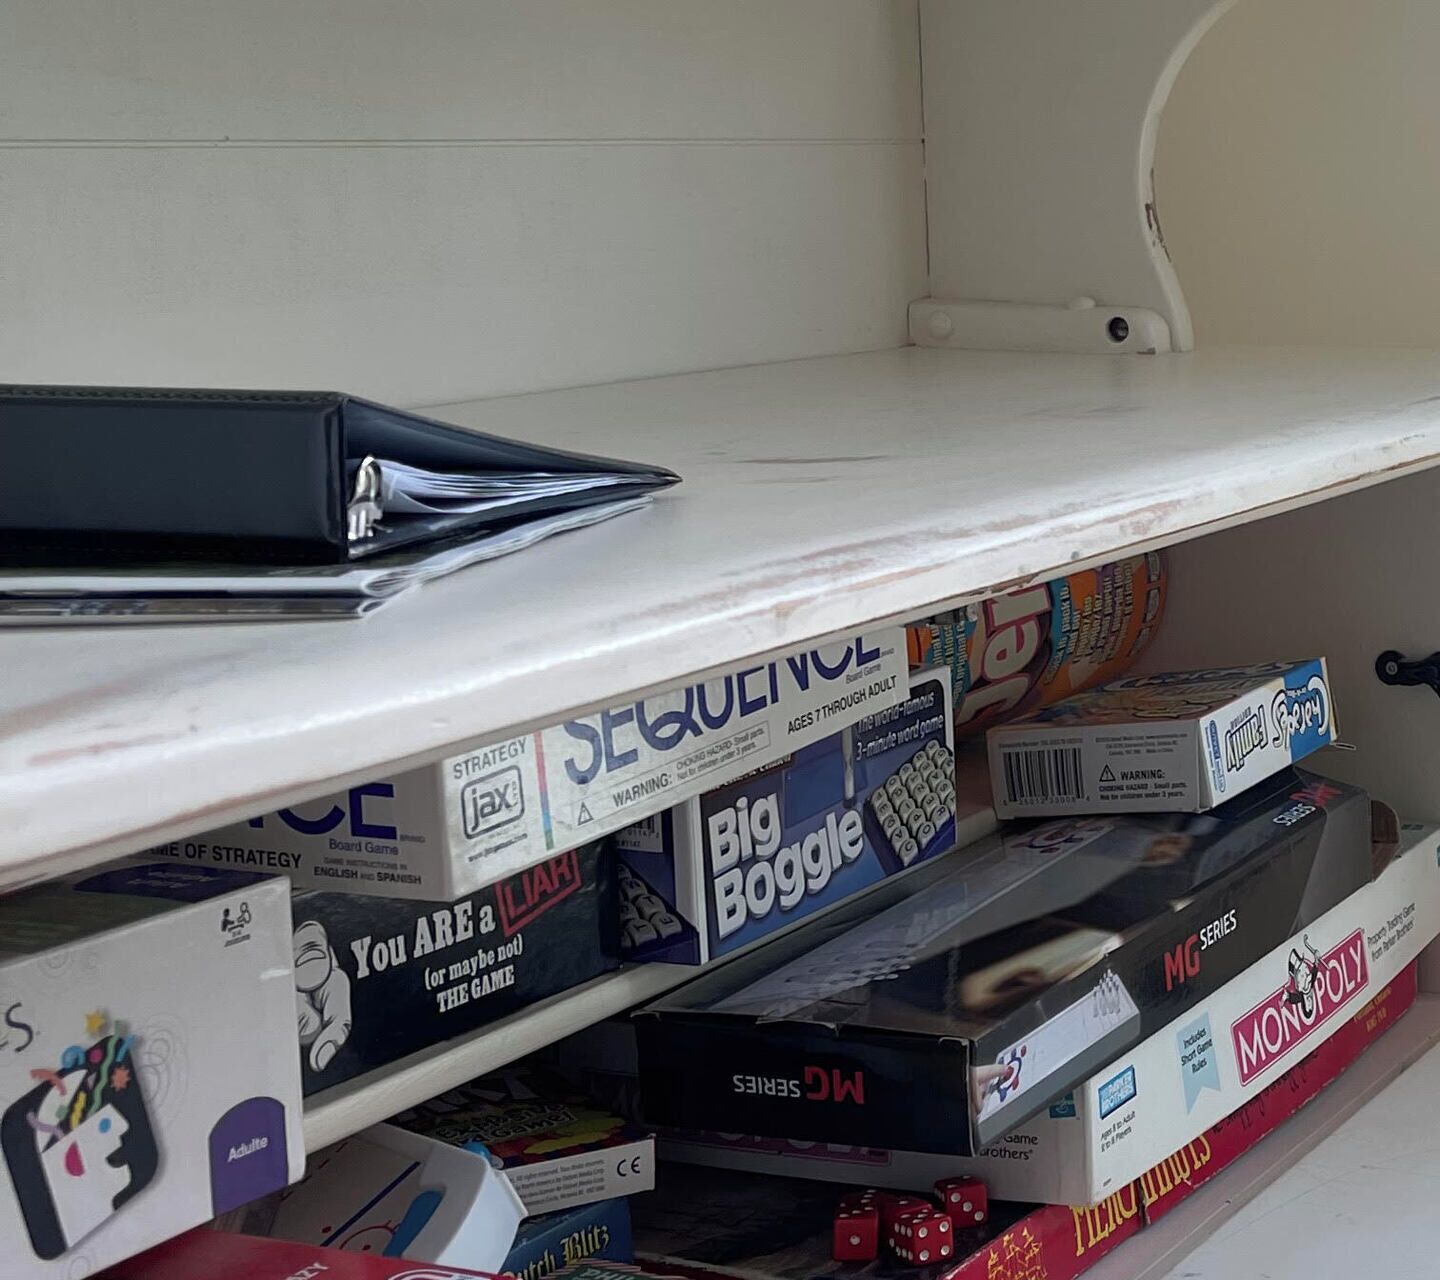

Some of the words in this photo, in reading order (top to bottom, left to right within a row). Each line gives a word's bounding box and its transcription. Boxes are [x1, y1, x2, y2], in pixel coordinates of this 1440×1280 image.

[787, 710, 814, 735] AGES
[814, 706, 823, 721] 7
[822, 686, 866, 720] THROUGH
[867, 674, 898, 700] ADULT
[1271, 675, 1331, 751] Charades
[453, 737, 528, 780] STRATEGY
[855, 726, 898, 762] 3-minute
[896, 717, 921, 745] word
[918, 713, 945, 740] game
[1224, 704, 1269, 772] Family
[613, 771, 674, 808] WARNING:
[1120, 769, 1166, 781] WARNING:
[470, 781, 513, 832] jax
[328, 838, 362, 854] Board
[364, 841, 400, 857] Game
[707, 793, 782, 874] Big
[184, 843, 207, 859] OF
[212, 844, 303, 869] STRATEGY
[313, 866, 358, 880] ENGLISH
[376, 872, 422, 885] SPANISH
[714, 809, 865, 940] Boggle
[350, 934, 407, 980] You
[412, 900, 474, 959] ARE
[479, 904, 496, 936] a
[503, 850, 574, 919] LIAR
[424, 966, 447, 991] (or
[448, 946, 496, 982] maybe
[496, 933, 524, 964] not)
[1164, 933, 1201, 992] MG
[1200, 909, 1238, 951] SERIES
[436, 985, 469, 1014] THE
[470, 965, 516, 1002] GAME
[1238, 939, 1362, 1075] MONOPOLY
[1181, 1050, 1197, 1068] Short
[1196, 1036, 1214, 1058] Game
[1182, 1027, 1208, 1050] Includes
[732, 1073, 802, 1100] SERIES
[803, 1065, 867, 1106] MG
[1191, 1057, 1208, 1075] Rules
[226, 1133, 269, 1163] Adulte
[560, 1223, 611, 1266] Blitz
